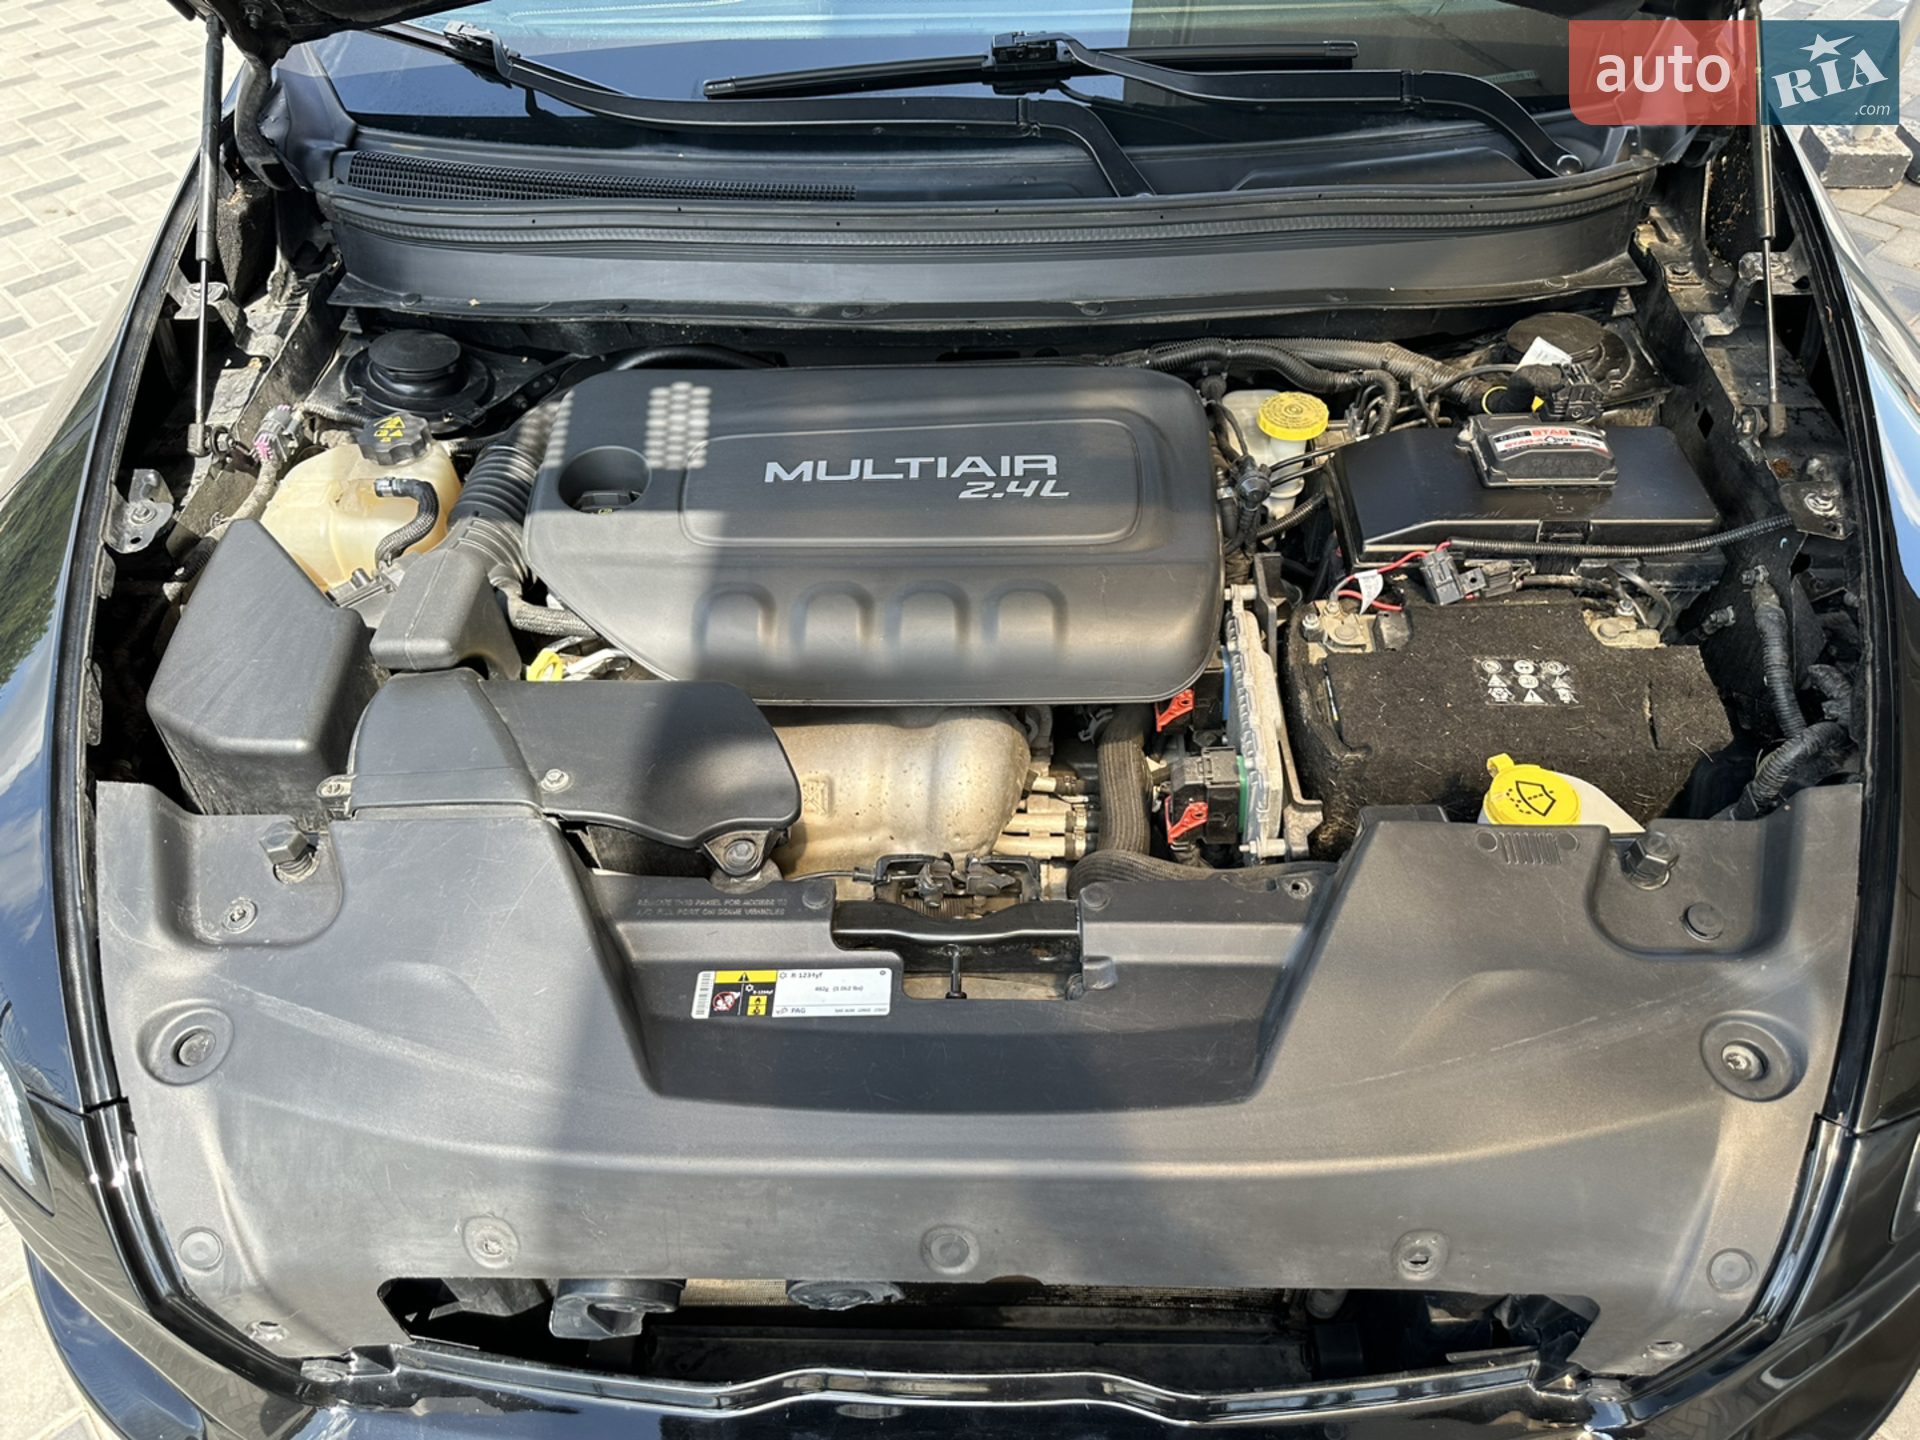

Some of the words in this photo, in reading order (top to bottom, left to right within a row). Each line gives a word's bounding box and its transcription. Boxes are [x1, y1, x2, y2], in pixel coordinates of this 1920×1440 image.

[1531, 428, 1570, 436] STAG
[764, 454, 1058, 483] MULTIAIR
[958, 480, 1070, 499] 2.4L
